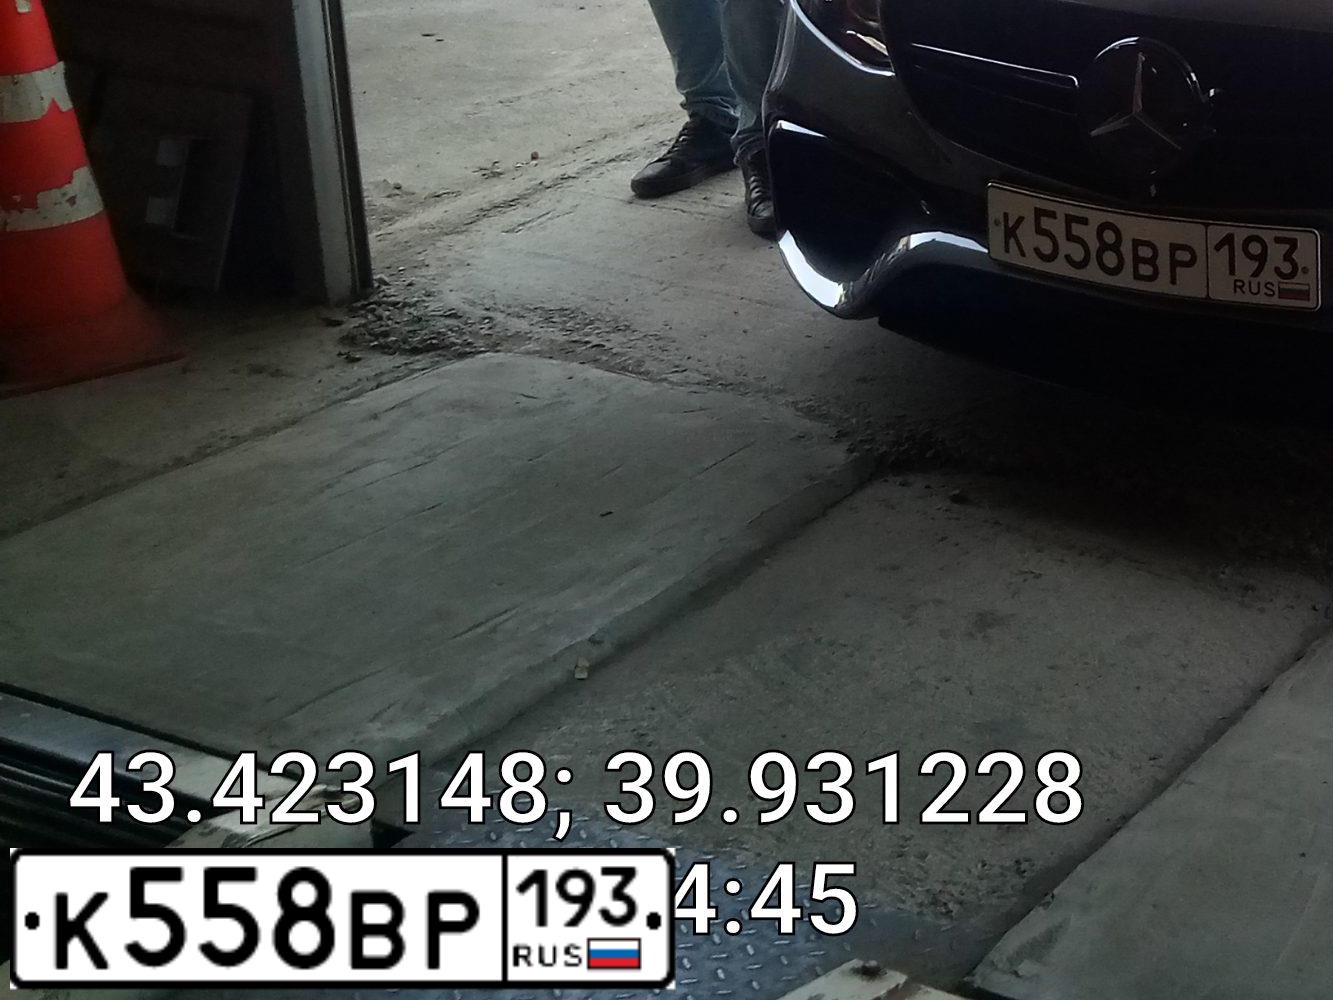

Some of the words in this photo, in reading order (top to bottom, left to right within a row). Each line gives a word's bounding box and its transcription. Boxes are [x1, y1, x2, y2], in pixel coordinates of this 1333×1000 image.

[1003, 206, 1198, 286] К558ВР
[1213, 232, 1299, 280] 193
[1233, 279, 1276, 298] RUS
